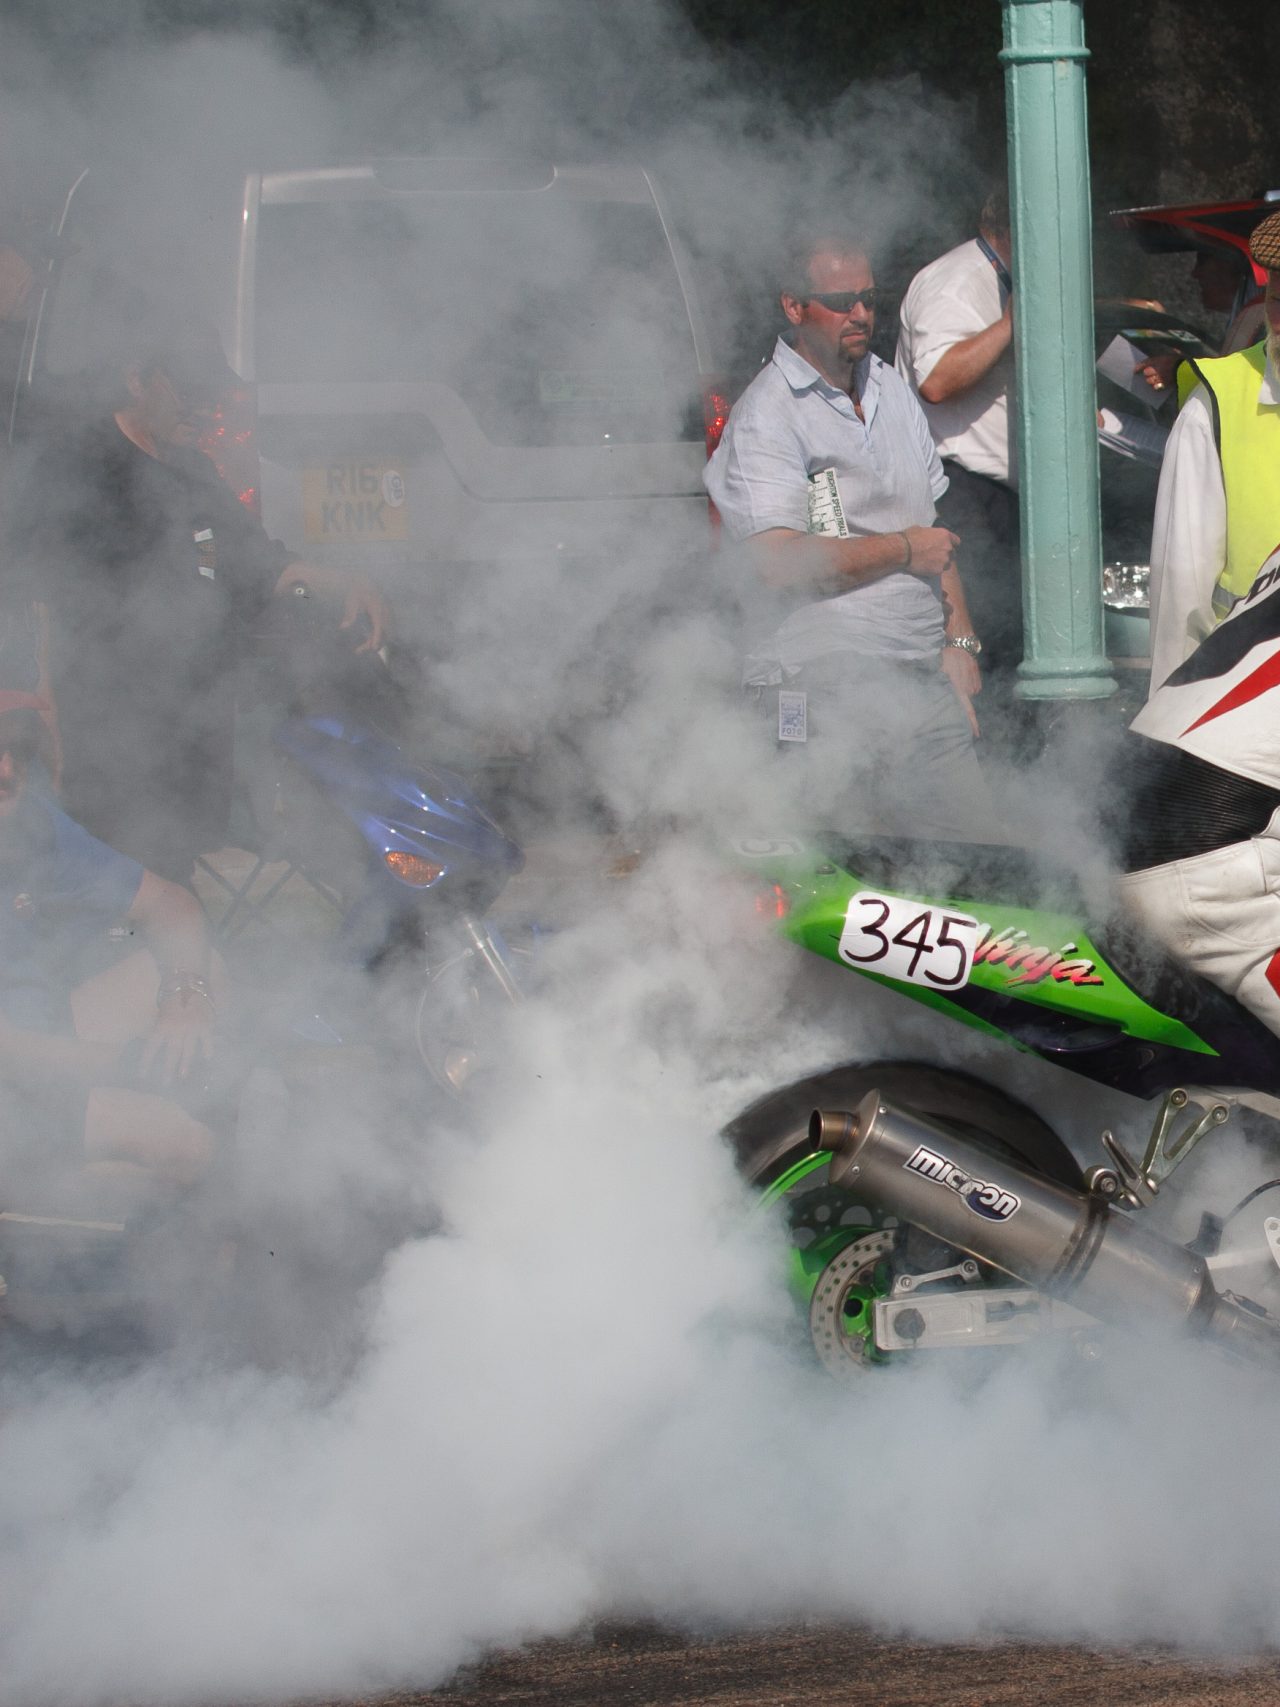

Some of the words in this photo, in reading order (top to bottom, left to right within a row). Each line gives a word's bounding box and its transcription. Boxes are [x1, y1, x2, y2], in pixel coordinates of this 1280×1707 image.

[321, 500, 387, 534] KNK
[831, 498, 842, 517] SPEED
[836, 516, 848, 537] TRIALS
[844, 899, 977, 986] 345
